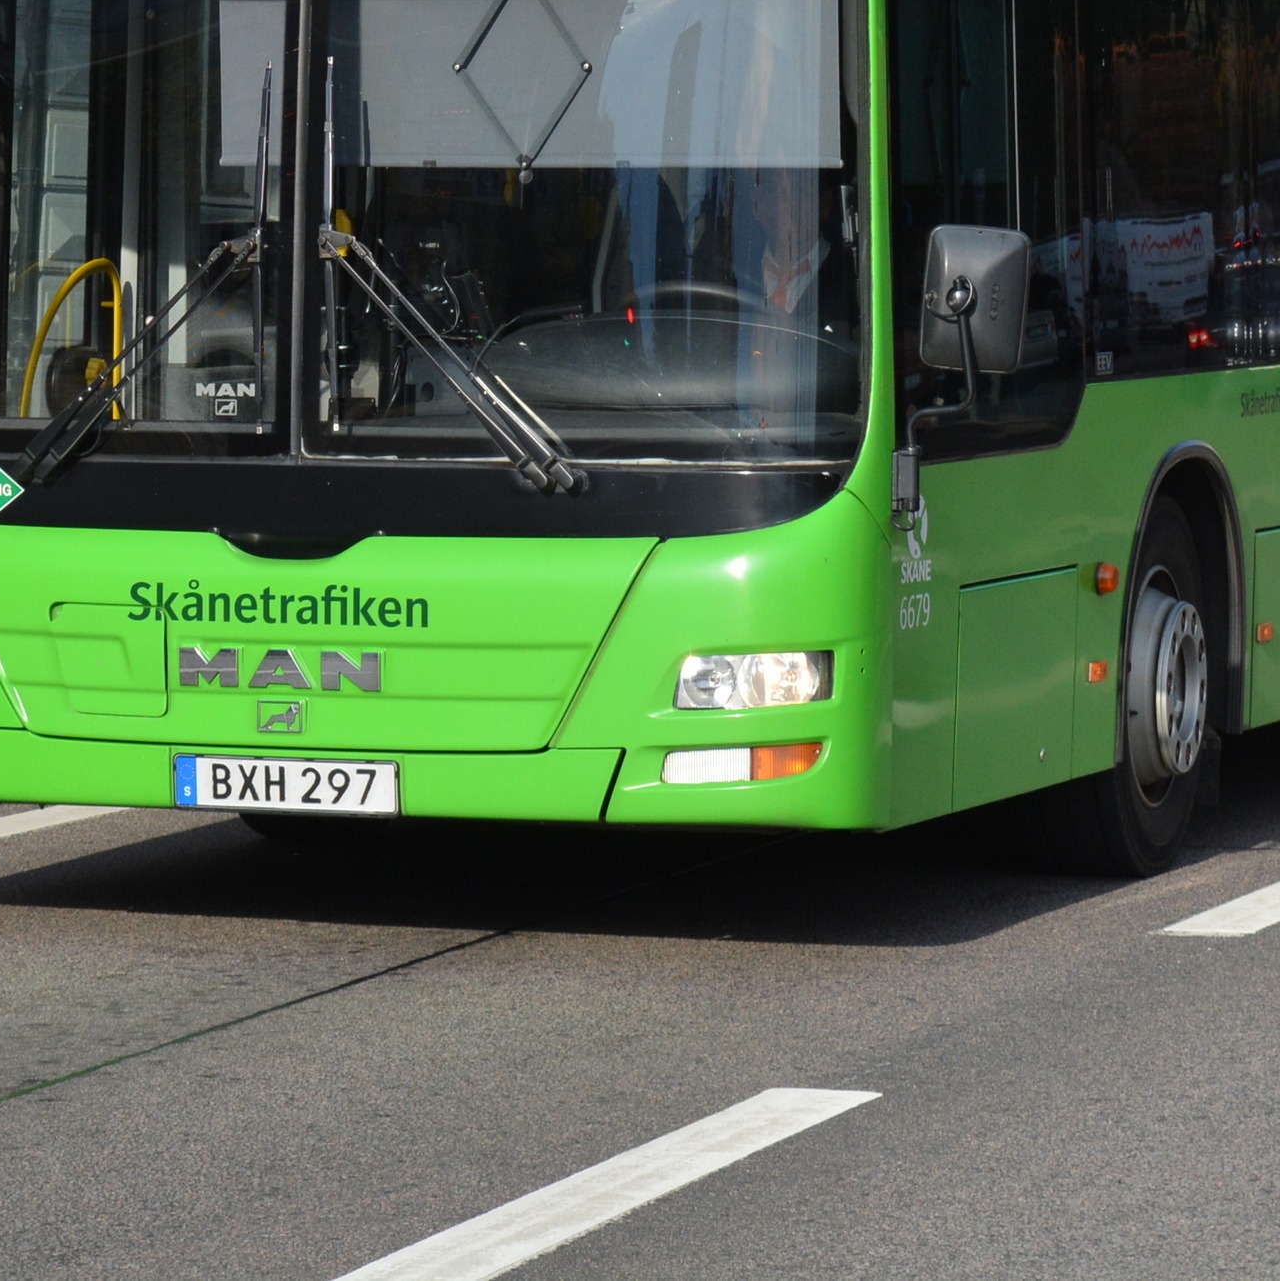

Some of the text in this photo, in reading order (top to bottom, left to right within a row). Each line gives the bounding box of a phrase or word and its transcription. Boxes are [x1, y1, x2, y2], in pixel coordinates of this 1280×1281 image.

[1097, 353, 1112, 373] EEV
[195, 382, 256, 397] MAN
[128, 580, 430, 629] Skånetrafiken
[899, 592, 931, 630] 6679
[178, 646, 384, 693] MAN
[183, 785, 192, 797] S
[211, 763, 378, 806] BXH 297
